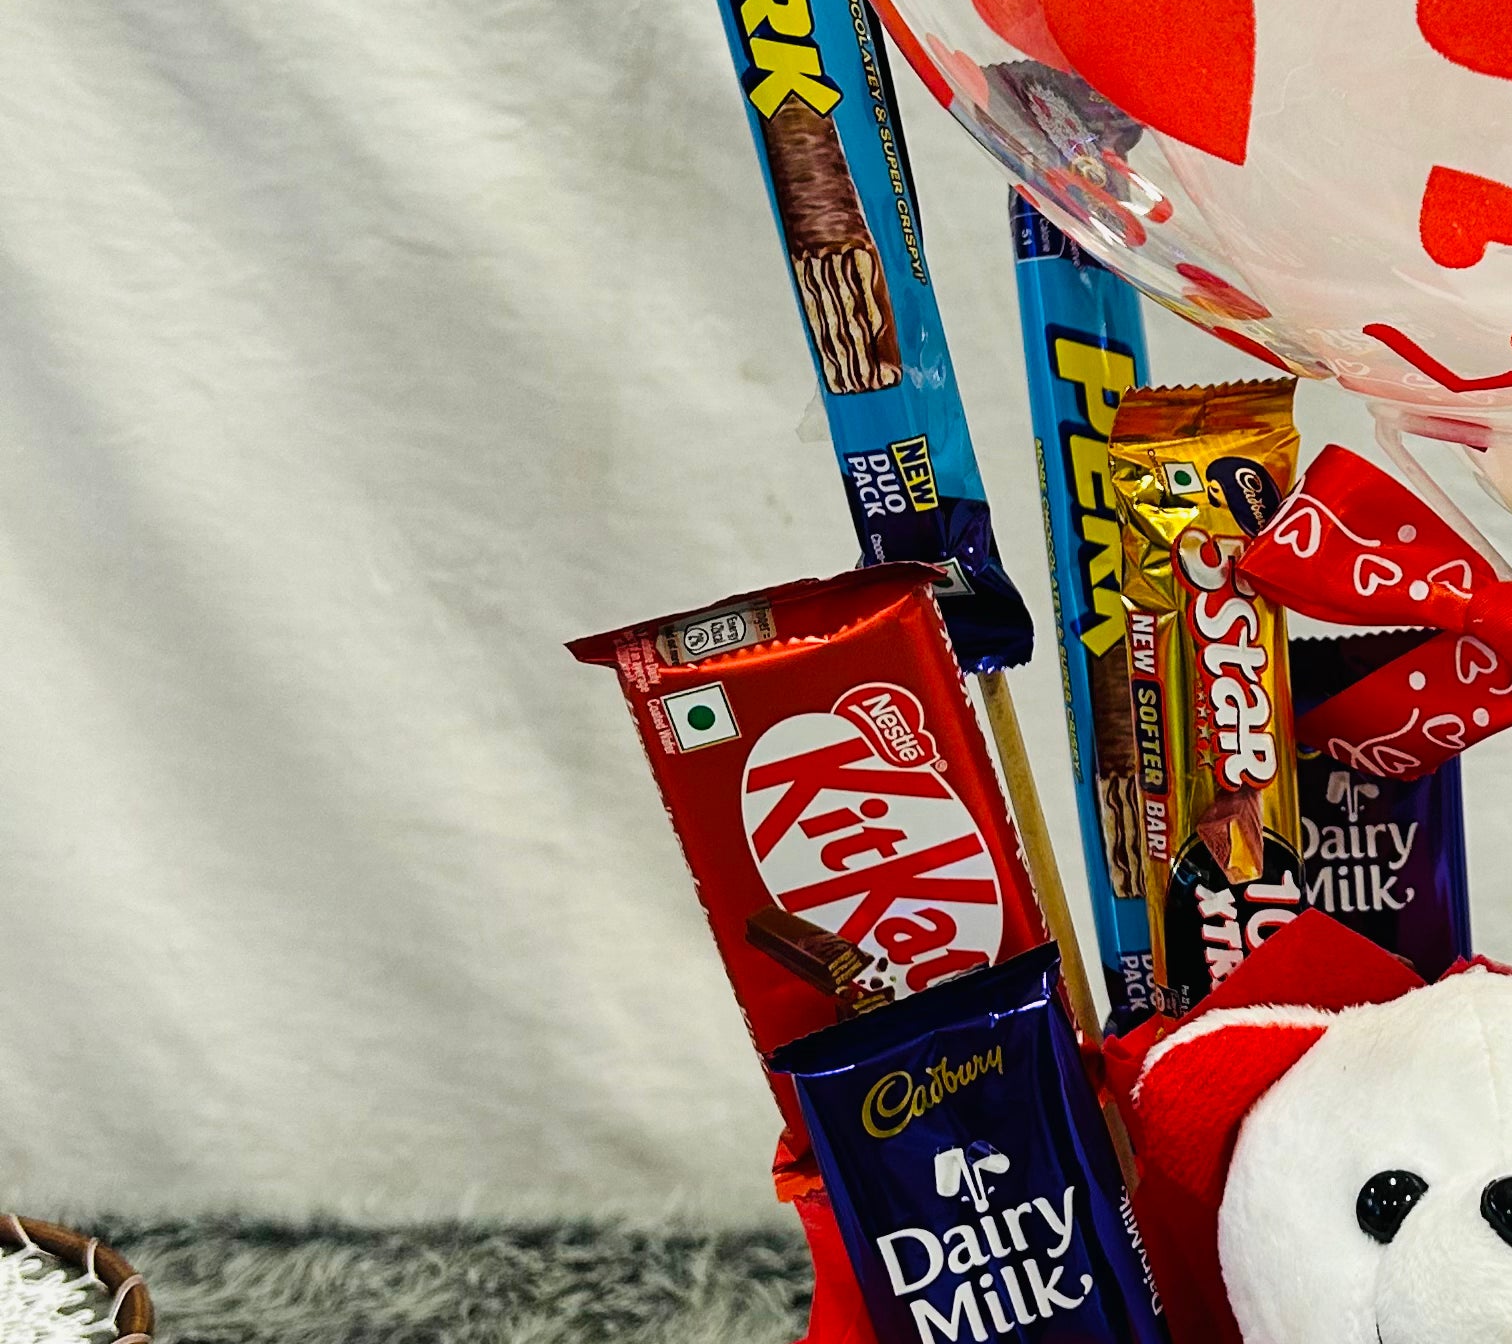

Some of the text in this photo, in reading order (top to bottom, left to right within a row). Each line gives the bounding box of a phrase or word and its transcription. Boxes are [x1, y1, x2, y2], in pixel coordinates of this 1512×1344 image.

[880, 127, 903, 195] SUPER
[847, 456, 887, 518] PACK
[867, 452, 907, 514] DUO
[894, 438, 937, 506] NEW
[1131, 612, 1155, 675] NEW
[1137, 686, 1162, 790] SOFTER
[745, 735, 1000, 993] KitKat
[1145, 798, 1168, 862] BAR!
[1196, 884, 1245, 992] XTR
[1119, 955, 1149, 1013] PACK
[861, 1044, 1005, 1140] Cadbury
[876, 1184, 1076, 1297] Dairy
